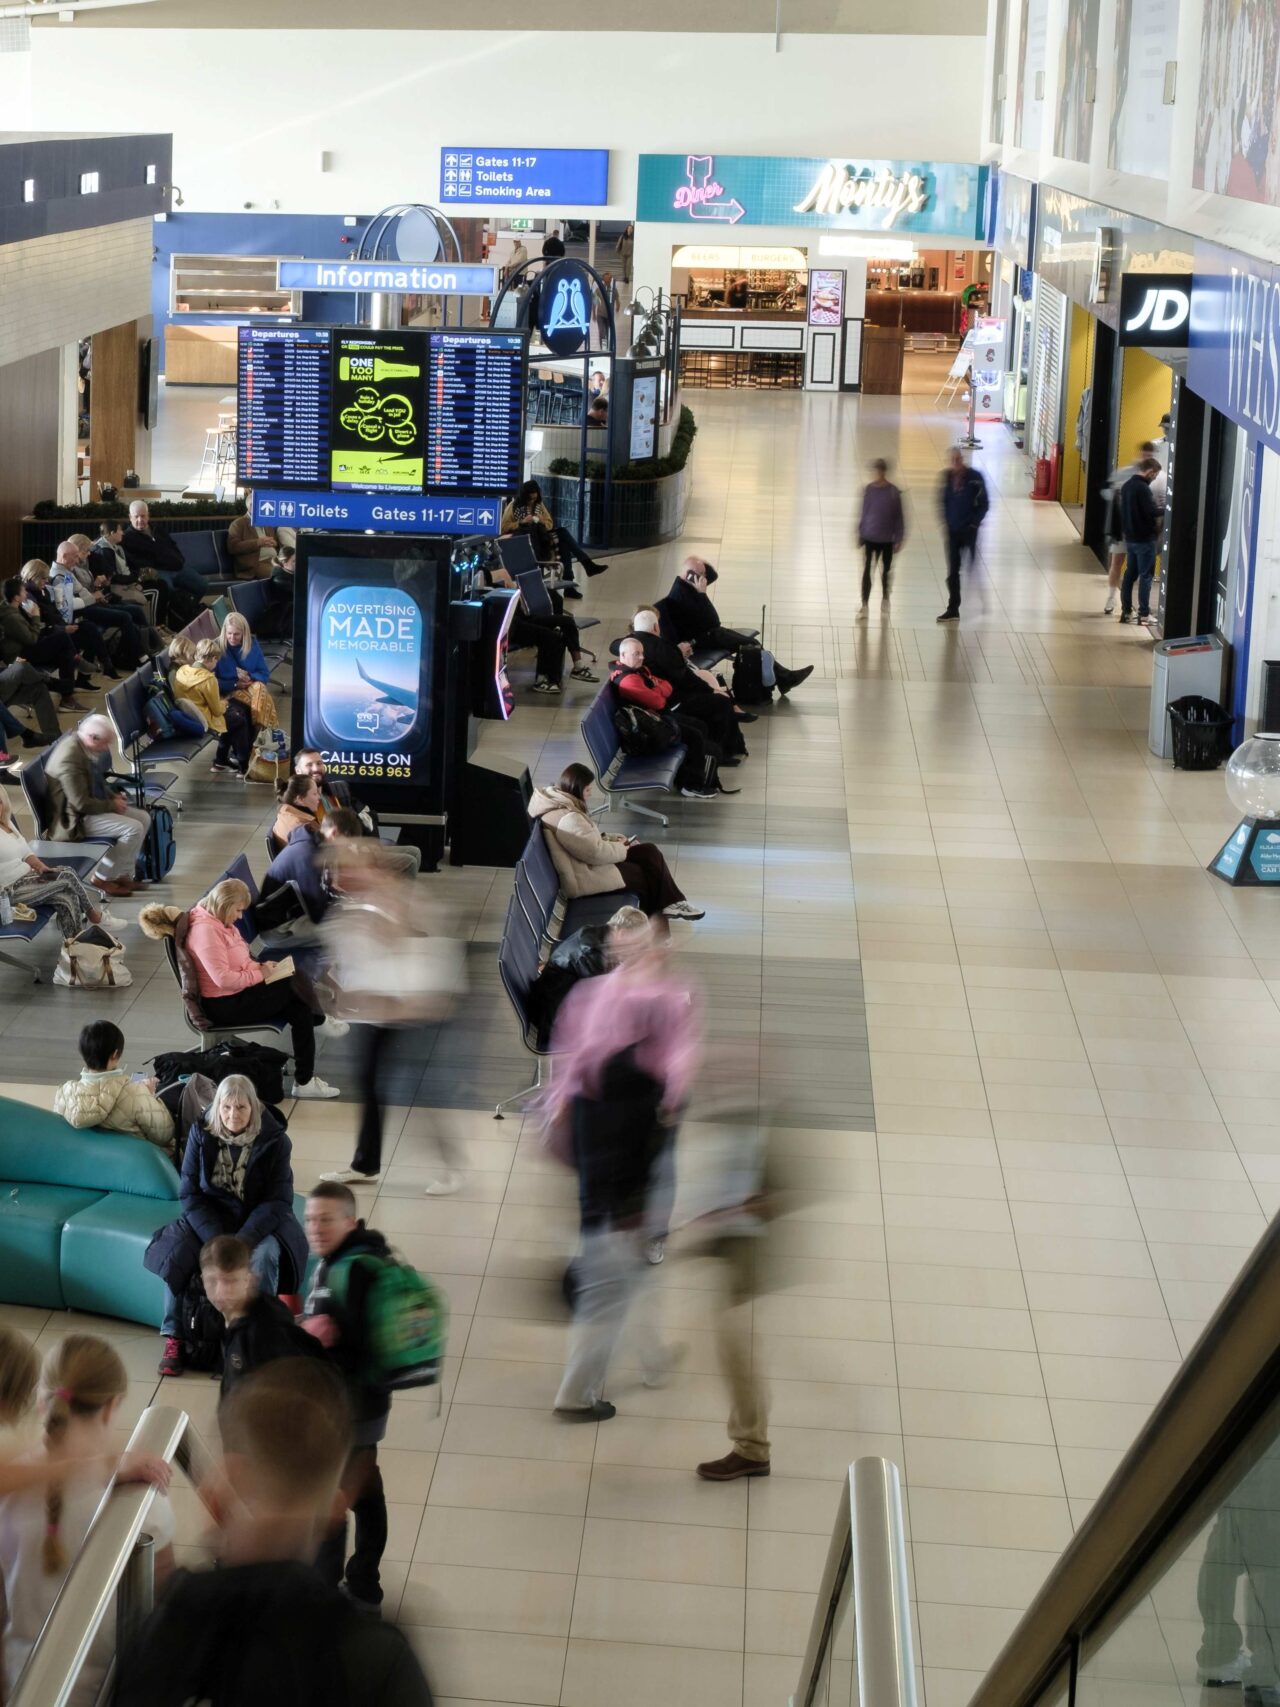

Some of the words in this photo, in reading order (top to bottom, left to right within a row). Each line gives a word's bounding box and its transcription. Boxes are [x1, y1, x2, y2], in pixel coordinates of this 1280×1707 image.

[475, 156, 509, 168] Gates
[512, 157, 537, 168] 11-17
[476, 171, 513, 182] Toilets
[475, 185, 522, 198] Smoking
[526, 187, 551, 197] Area
[673, 182, 724, 208] Diner
[793, 164, 926, 229] Monty's
[751, 254, 795, 263] BURGERS
[317, 264, 457, 290] Information
[1125, 289, 1190, 331] JD
[251, 330, 300, 339] Departures
[442, 335, 492, 344] Departures
[1228, 267, 1280, 440] WHS
[350, 357, 374, 367] ONE
[351, 366, 373, 374] TOO
[299, 502, 348, 518] Toilets
[371, 506, 416, 522] Gates
[422, 507, 454, 522] 11-17
[327, 603, 416, 616] ADVERTISING
[329, 616, 414, 639] MADE
[327, 639, 414, 653] MEMORABLE
[320, 751, 359, 764] CALL
[364, 752, 384, 766] US
[387, 753, 411, 766] ON
[358, 765, 384, 777] 638
[386, 766, 411, 778] 963
